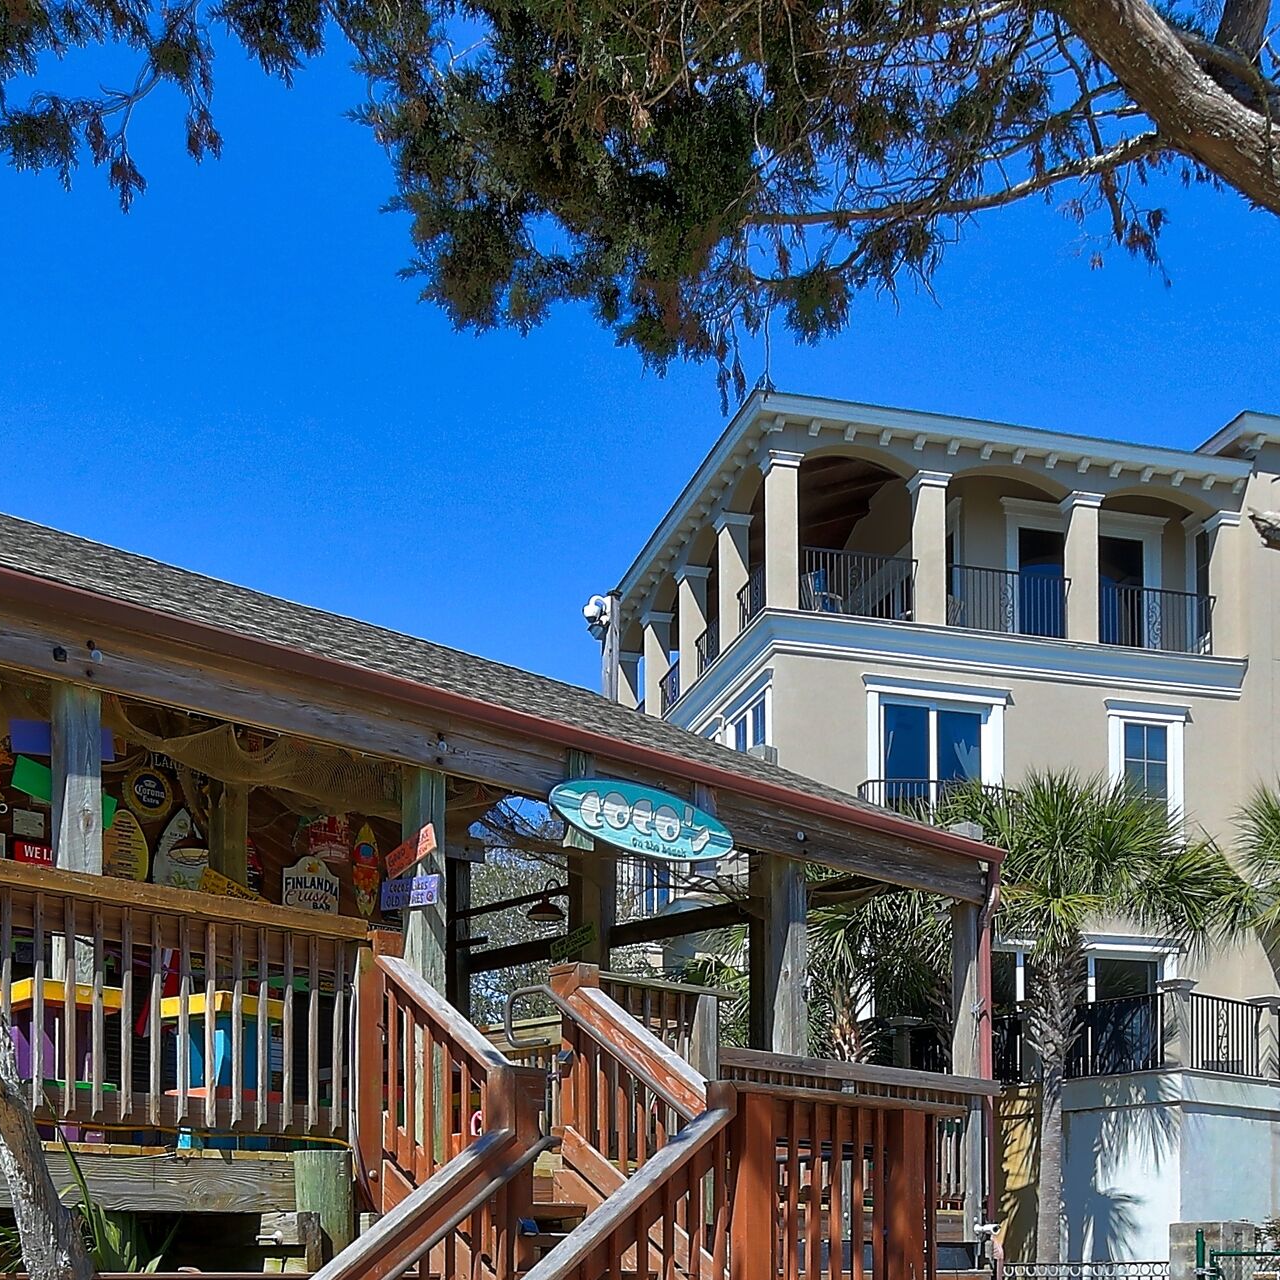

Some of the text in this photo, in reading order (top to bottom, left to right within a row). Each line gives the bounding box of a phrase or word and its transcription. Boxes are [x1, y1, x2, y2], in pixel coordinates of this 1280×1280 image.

[134, 784, 166, 799] Corona
[24, 844, 41, 859] WE
[284, 876, 339, 900] FINLANDIA
[312, 901, 331, 911] BAR
